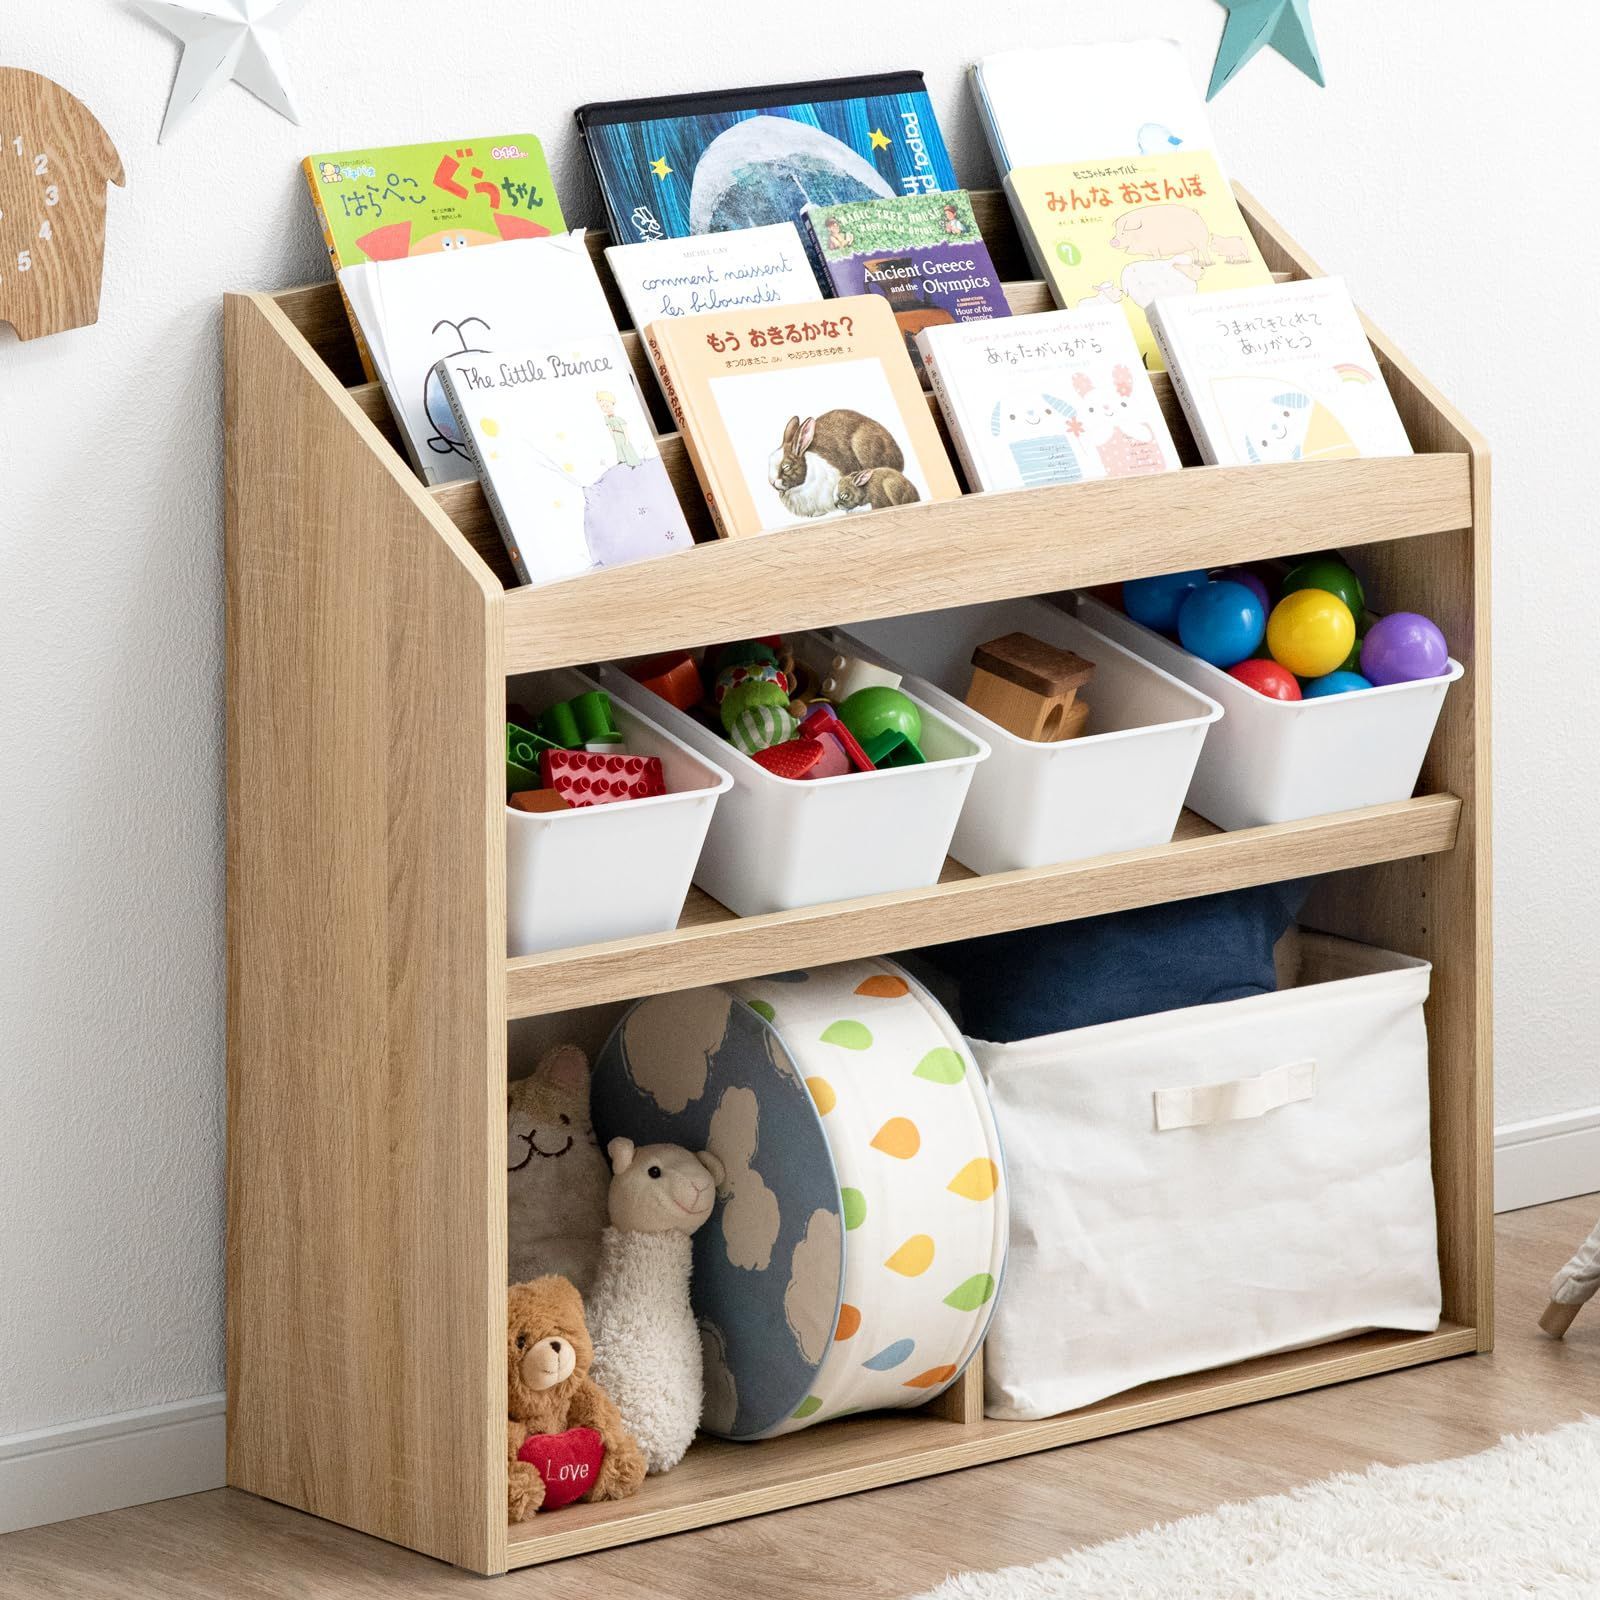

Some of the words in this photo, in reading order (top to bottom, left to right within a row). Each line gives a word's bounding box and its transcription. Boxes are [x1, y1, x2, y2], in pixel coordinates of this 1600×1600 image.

[13, 136, 23, 156] 1
[34, 153, 48, 175] 2
[340, 173, 426, 218] はらぺこ
[432, 148, 544, 211] ぐうちゃん
[1045, 186, 1114, 212] みんな
[1118, 174, 1206, 204] おさんぽ
[45, 185, 59, 206] 3
[840, 209, 871, 225] MAGIC
[875, 209, 903, 221] TREE
[908, 206, 942, 223] HOUSE
[39, 220, 52, 241] 4
[860, 222, 905, 234] RESEARCH
[17, 250, 32, 272] 5
[1060, 245, 1074, 265] 7
[642, 264, 719, 291] comment
[724, 251, 793, 280] naissent
[864, 263, 921, 283] Ancient
[922, 259, 976, 275] Greece
[890, 283, 906, 293] and
[906, 283, 919, 292] the
[922, 275, 991, 295] Olympics
[660, 294, 685, 317] les
[955, 308, 973, 316] Hour
[982, 305, 993, 313] the
[1216, 312, 1322, 337] うまれてきてくれて
[706, 331, 741, 353] もう
[984, 338, 1103, 365] あなたがいるから
[1237, 330, 1312, 355] ありがとう
[456, 367, 496, 390] The
[499, 359, 546, 388] Little
[546, 355, 613, 378] Prince
[725, 356, 769, 368] まつのまさこ
[452, 402, 460, 413] de
[546, 1459, 589, 1481] Love
